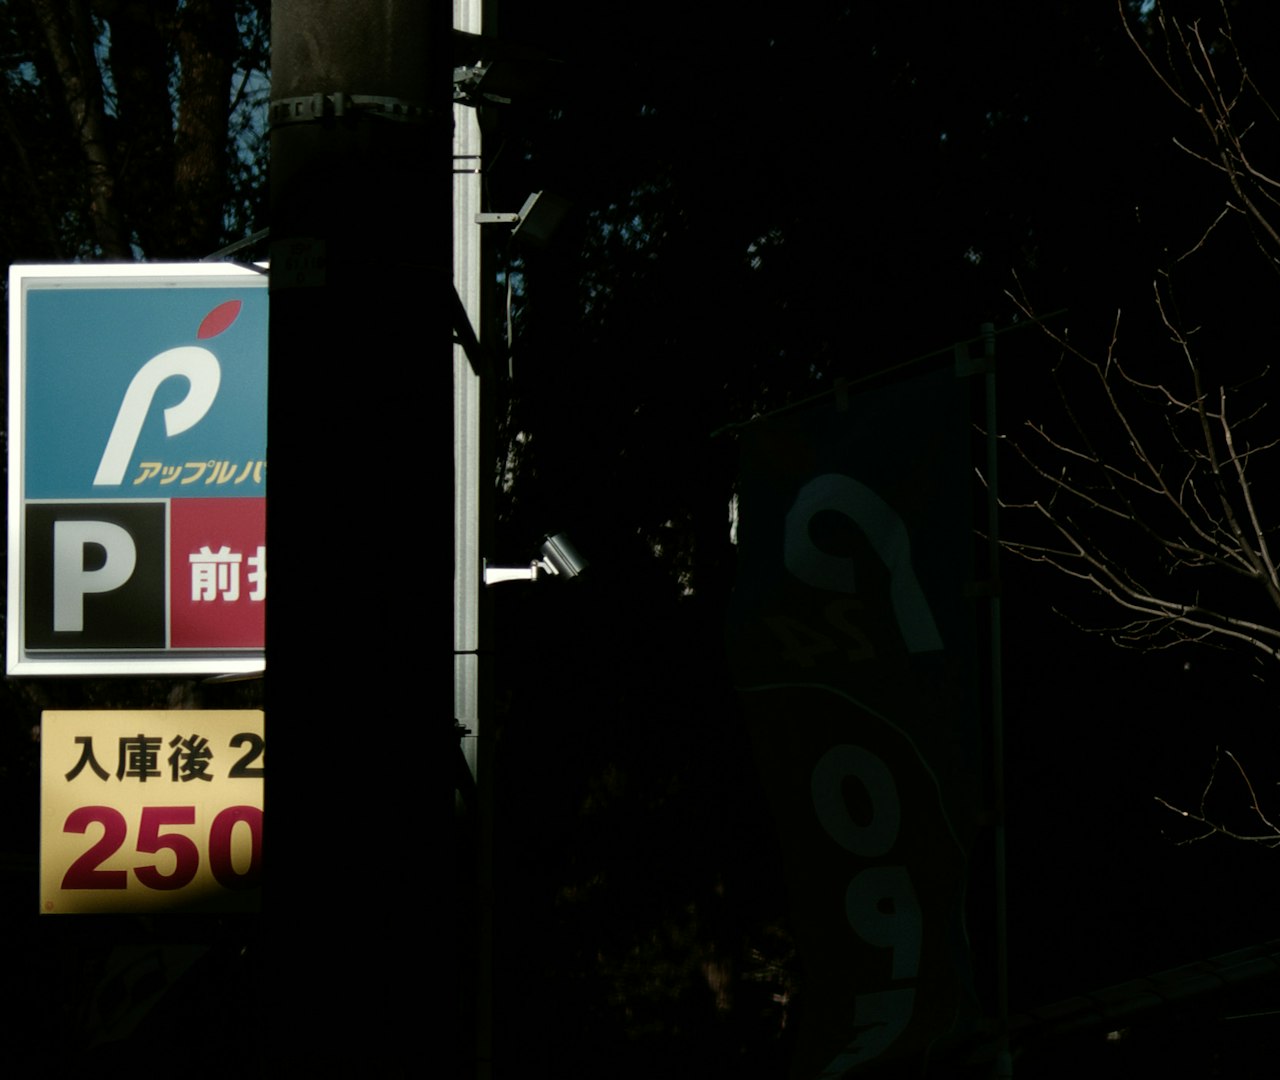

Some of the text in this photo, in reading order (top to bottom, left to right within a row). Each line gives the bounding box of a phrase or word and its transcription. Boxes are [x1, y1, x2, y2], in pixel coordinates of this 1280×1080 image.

[53, 519, 137, 632] P
[64, 733, 214, 782] 入庫後
[60, 805, 264, 891] 250
